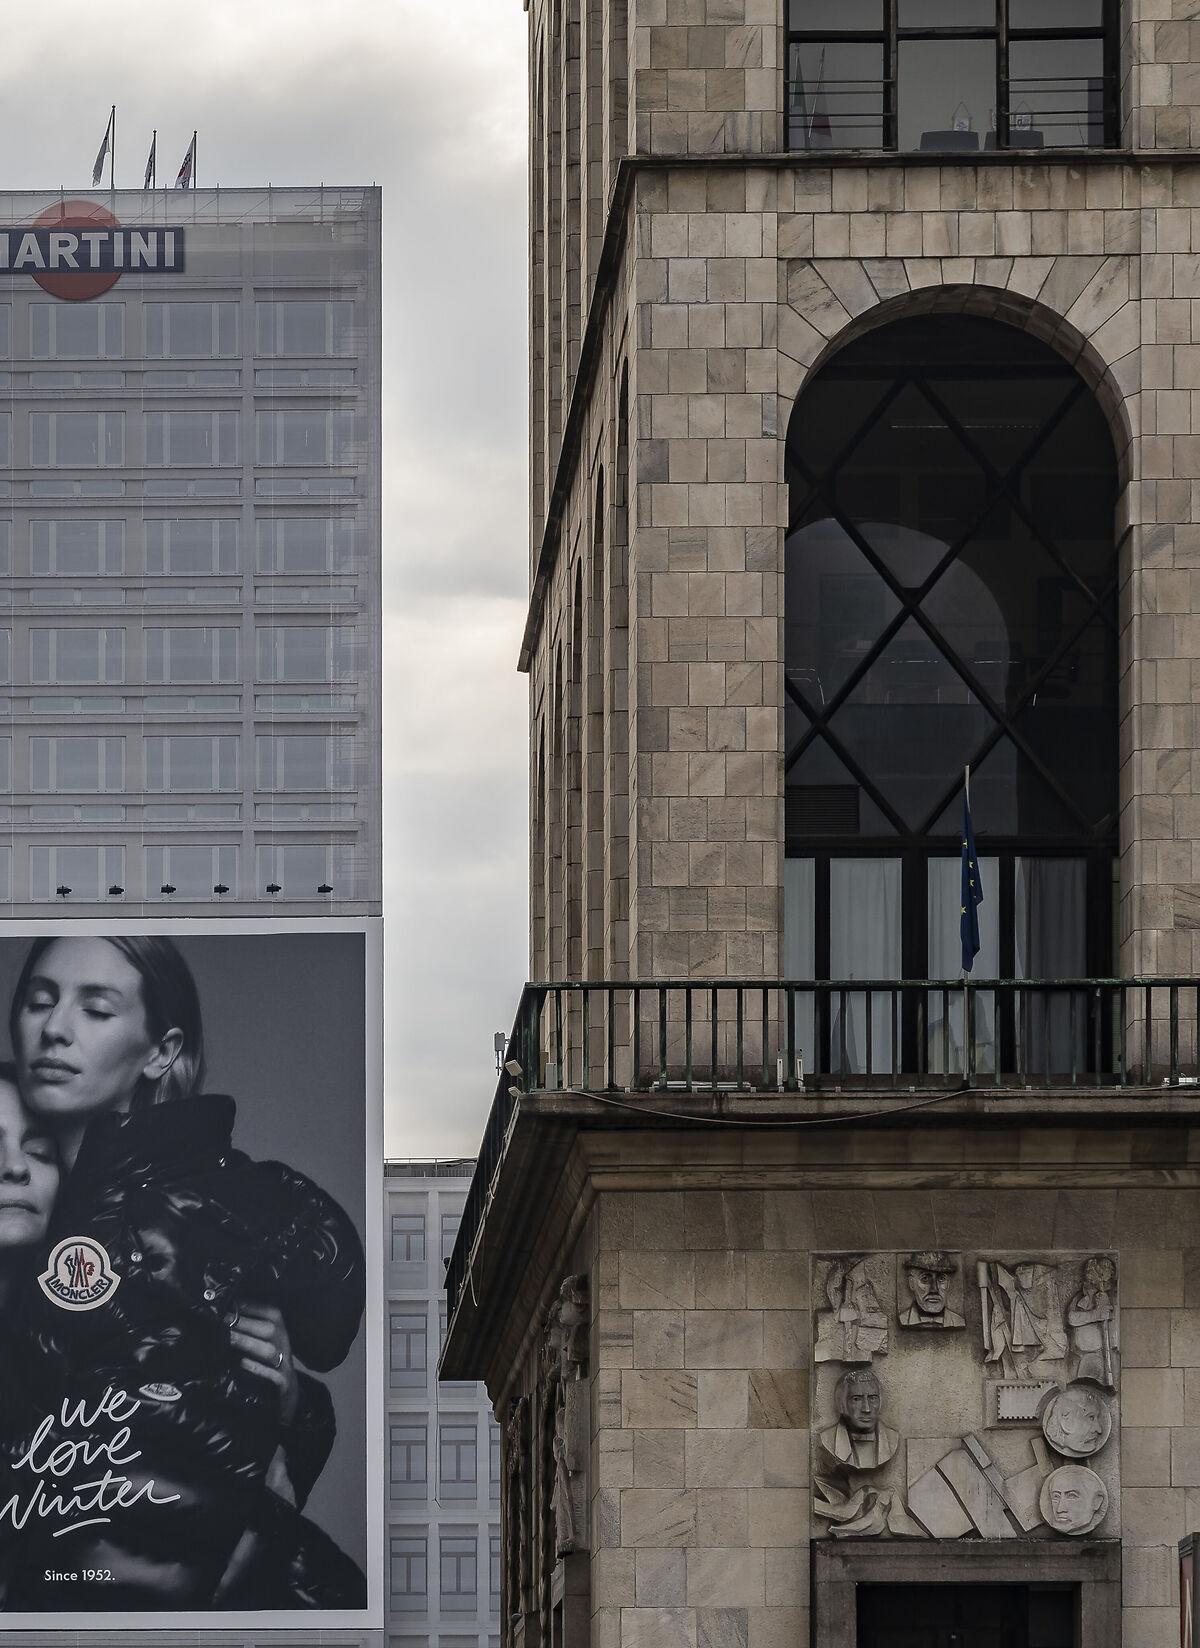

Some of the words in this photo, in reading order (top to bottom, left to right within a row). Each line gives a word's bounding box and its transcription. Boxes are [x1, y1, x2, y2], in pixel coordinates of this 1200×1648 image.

[50, 1278, 108, 1299] MONCLER
[11, 1414, 142, 1477] love
[44, 1569, 78, 1581] Since
[81, 1569, 116, 1581] 1952.
